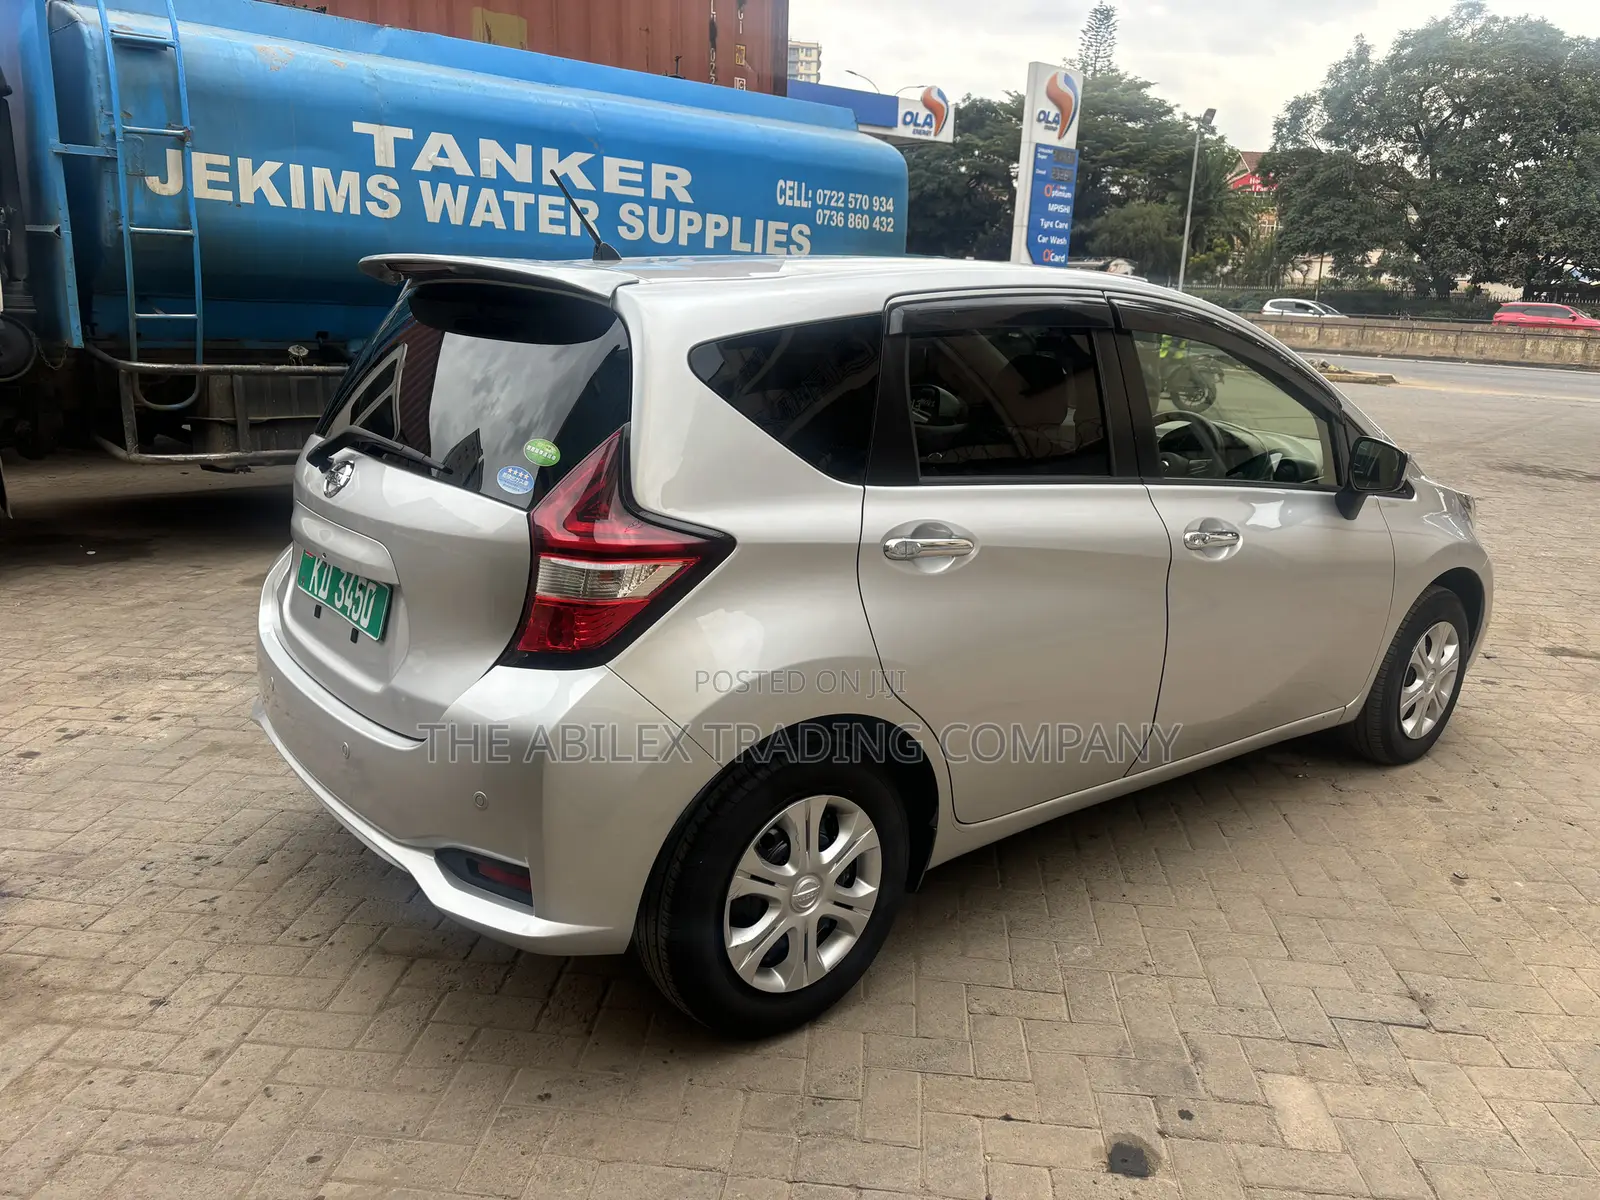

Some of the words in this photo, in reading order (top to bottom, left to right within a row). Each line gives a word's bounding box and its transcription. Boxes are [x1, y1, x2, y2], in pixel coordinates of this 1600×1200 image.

[902, 110, 934, 128] OLA
[1036, 110, 1060, 125] OLA
[352, 121, 694, 204] TANKER
[145, 148, 401, 219] JEKIMS
[418, 180, 600, 243] WATER
[617, 202, 811, 255] SUPPLIES
[776, 179, 812, 208] CELL:
[816, 188, 845, 207] 0722
[848, 193, 869, 210] 570
[872, 196, 894, 213] 934
[1048, 203, 1071, 214] MPISHI
[816, 208, 845, 227] 0736
[848, 213, 869, 230] 860
[872, 216, 894, 232] 432
[1040, 218, 1053, 229] Tyre
[1055, 220, 1069, 230] Care
[1037, 234, 1049, 243] Car
[1050, 236, 1067, 245] Wash
